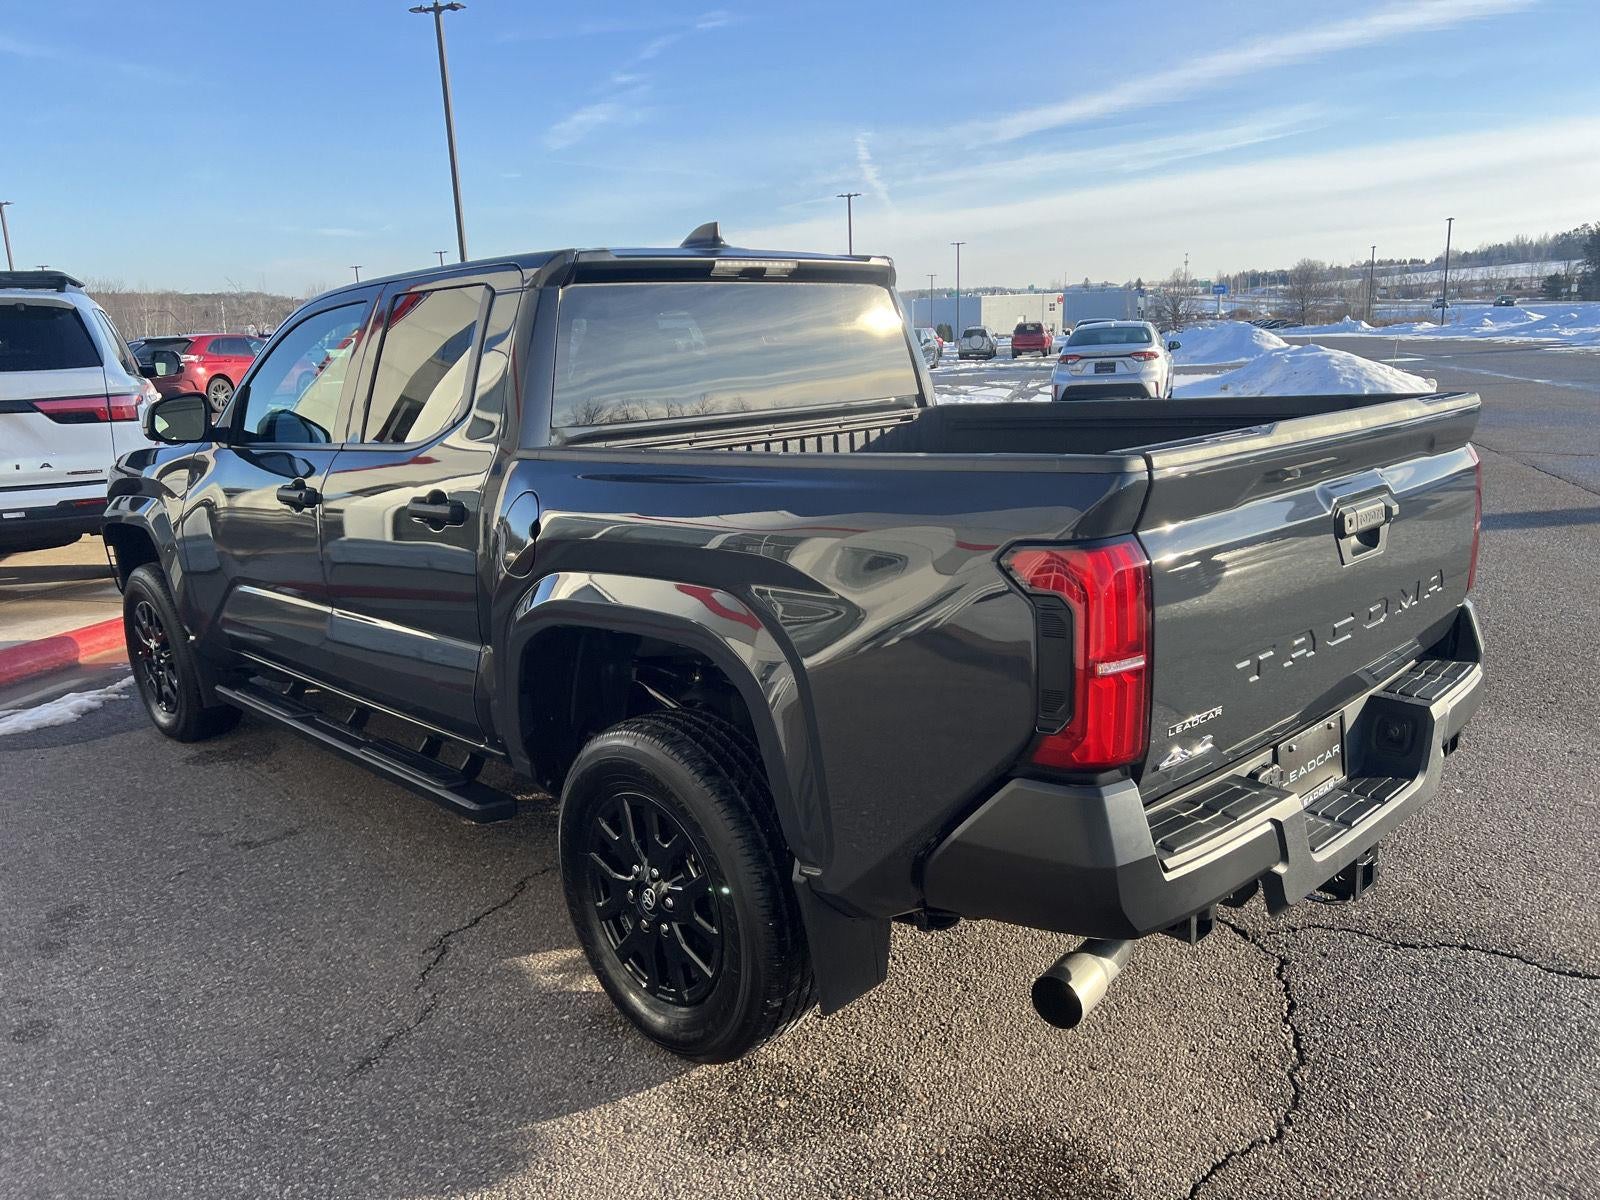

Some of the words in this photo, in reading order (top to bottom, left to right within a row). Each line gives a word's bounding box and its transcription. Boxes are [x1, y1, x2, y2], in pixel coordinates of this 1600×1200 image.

[1358, 507, 1385, 526] TOYOTA
[1235, 569, 1444, 683] TACOMA
[1168, 707, 1223, 737] LEADCAR
[1303, 780, 1335, 806] EADCAR
